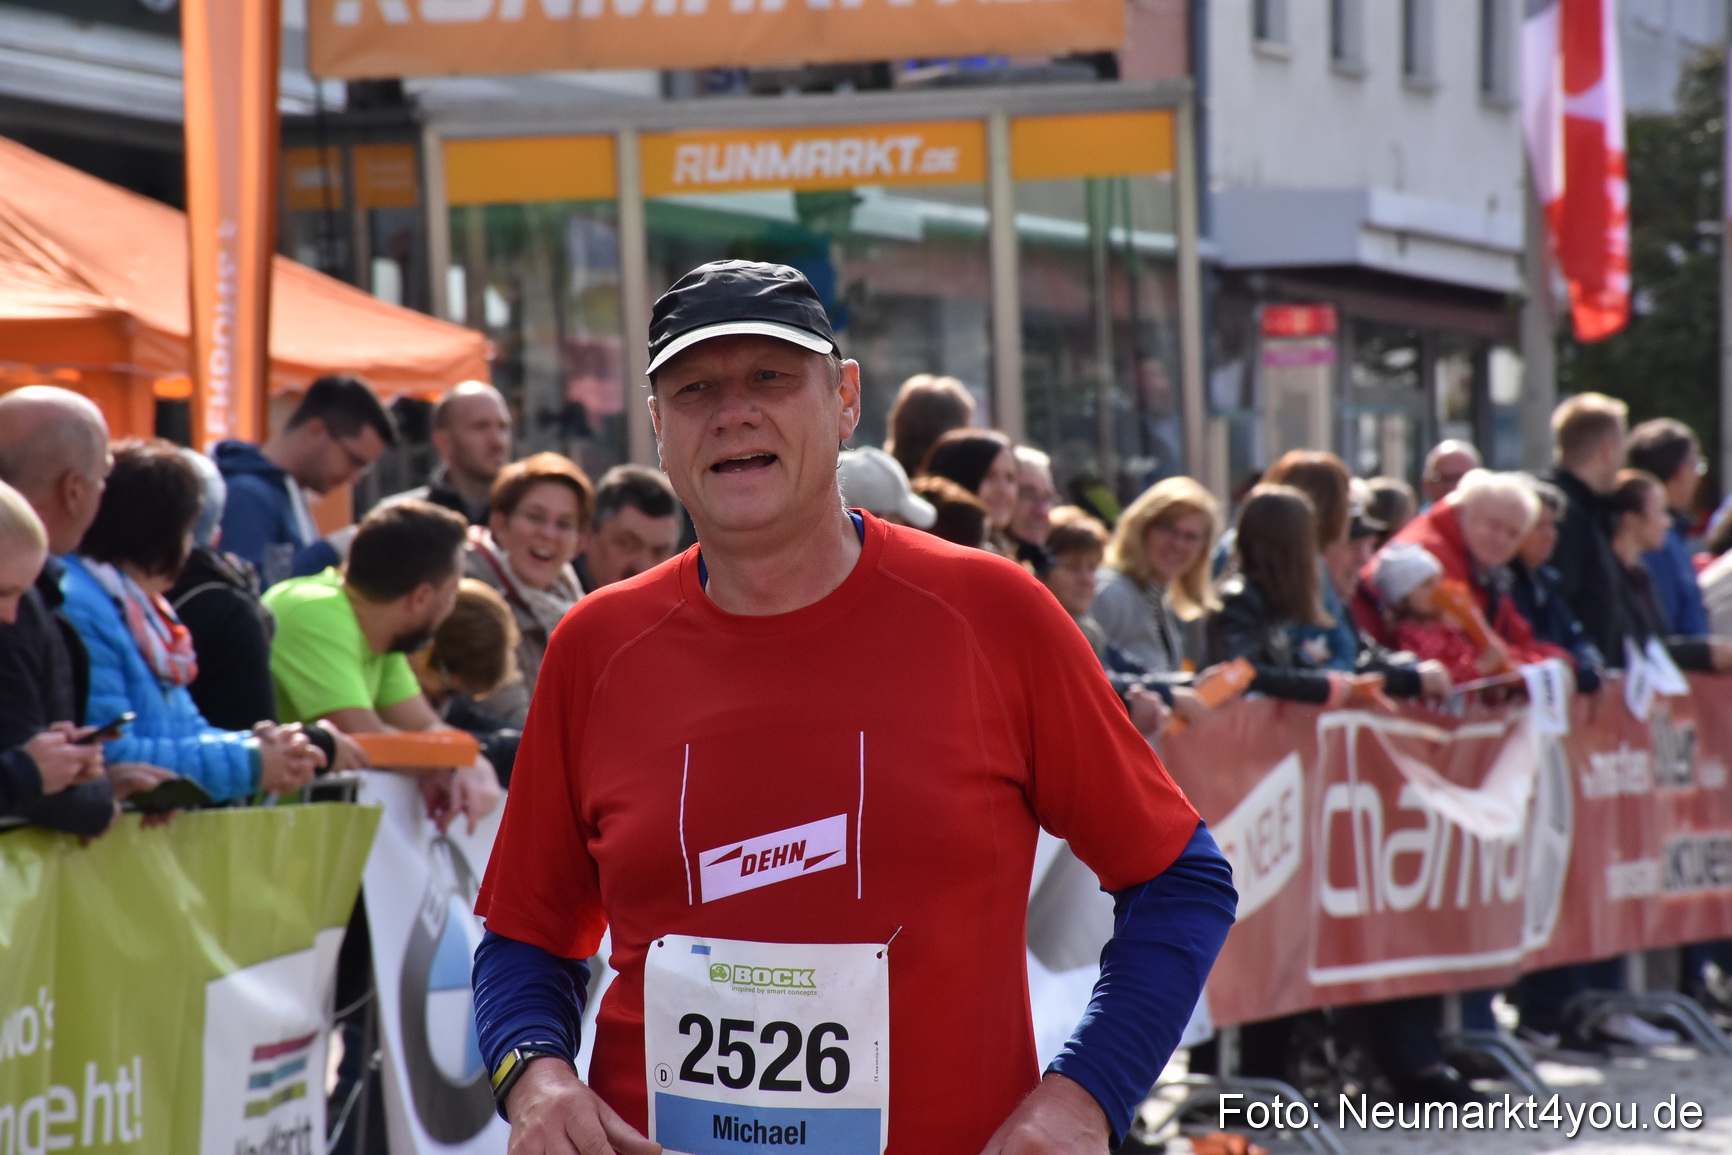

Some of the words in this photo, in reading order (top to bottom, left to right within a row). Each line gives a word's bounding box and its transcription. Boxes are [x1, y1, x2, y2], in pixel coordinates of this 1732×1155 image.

[740, 839, 807, 877] DEHN
[733, 965, 816, 988] BOCK
[731, 986, 756, 995] inspired
[678, 1012, 851, 1094] 2526
[660, 1069, 667, 1082] D
[713, 1114, 807, 1145] Michael
